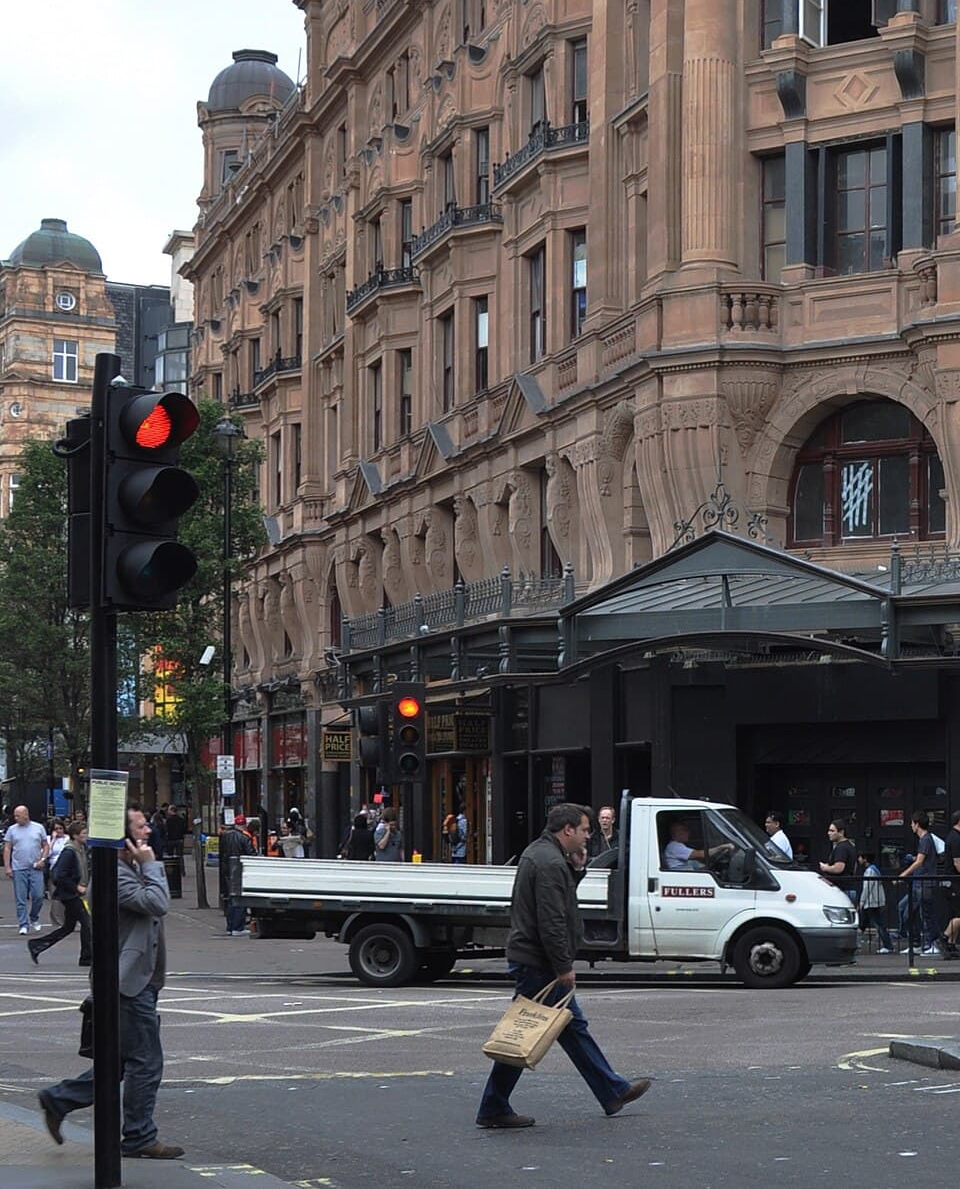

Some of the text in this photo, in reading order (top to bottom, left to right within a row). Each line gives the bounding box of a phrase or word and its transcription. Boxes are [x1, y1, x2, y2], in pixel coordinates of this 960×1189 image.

[325, 735, 351, 743] HALF
[325, 743, 351, 751] PRICE
[663, 887, 713, 896] FULLERS
